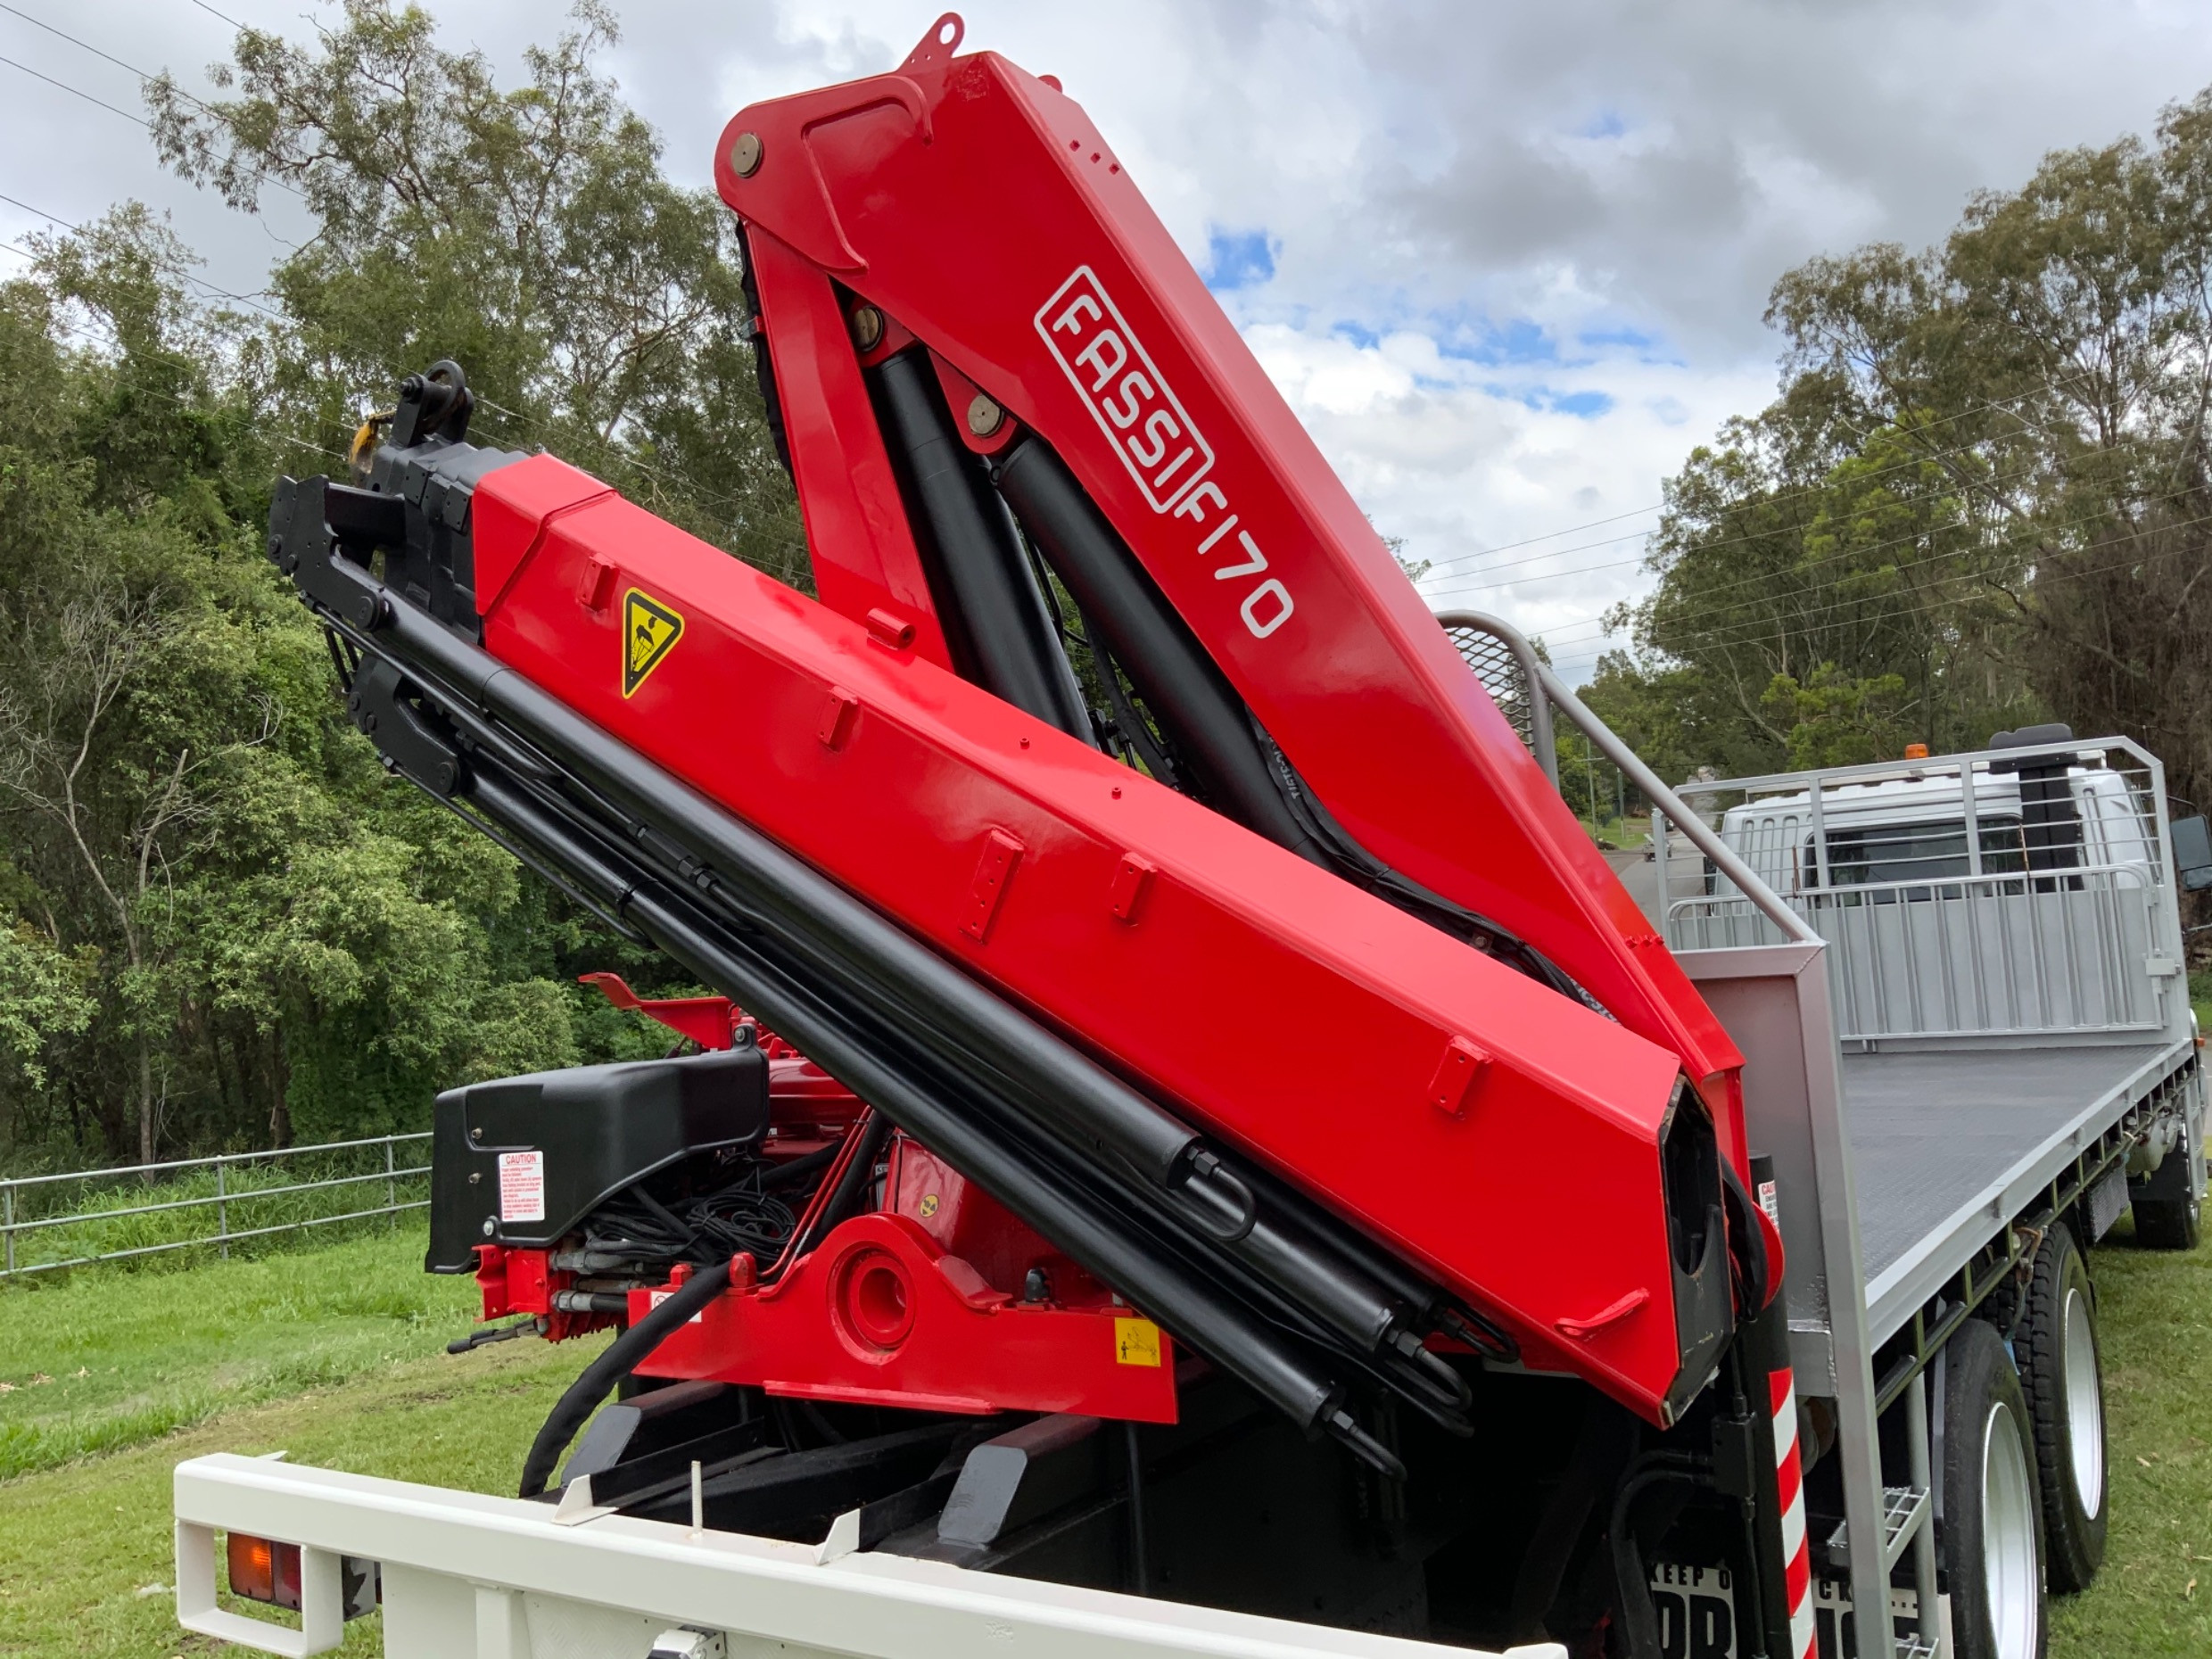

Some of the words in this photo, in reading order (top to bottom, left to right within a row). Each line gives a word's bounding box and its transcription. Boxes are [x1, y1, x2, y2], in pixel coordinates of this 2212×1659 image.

[1052, 294, 1193, 488] FASSI
[1174, 481, 1294, 639] F170
[505, 1153, 537, 1165] CAUTION
